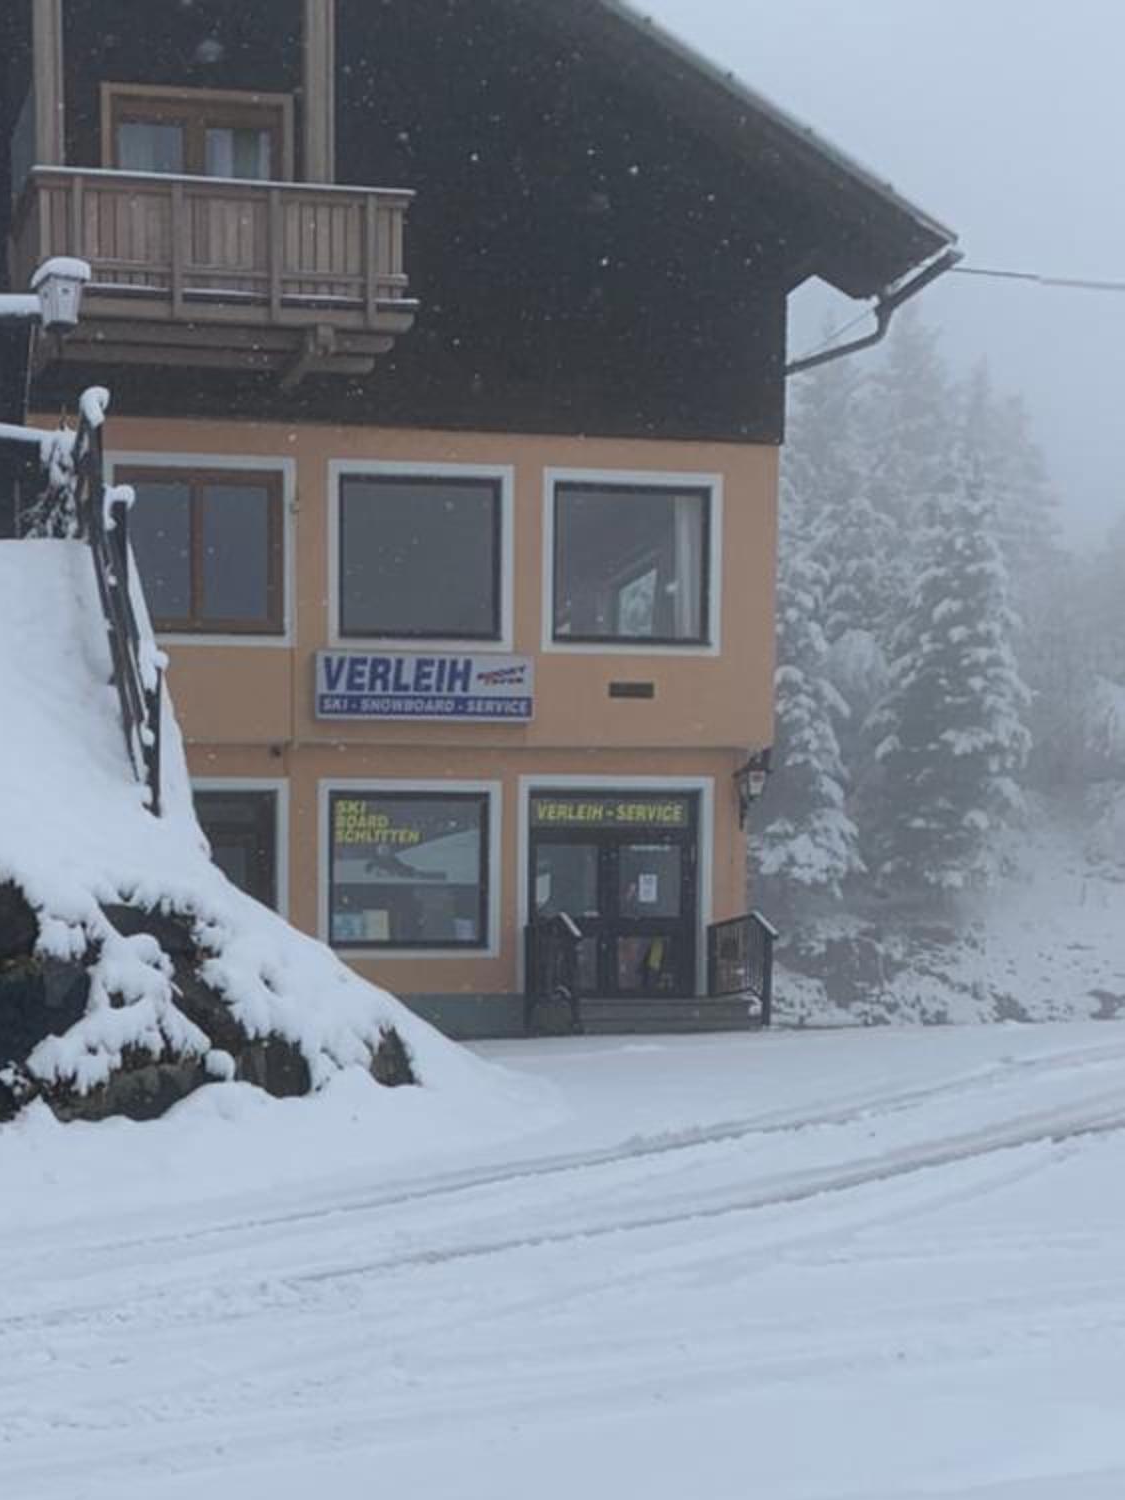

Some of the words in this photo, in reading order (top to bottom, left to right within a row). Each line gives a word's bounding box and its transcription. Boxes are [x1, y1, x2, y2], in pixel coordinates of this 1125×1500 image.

[324, 656, 473, 693] VERLEIH
[324, 699, 349, 711] SKI
[360, 700, 455, 713] SNOWBOARD
[466, 701, 530, 714] SERVICE
[336, 800, 366, 815] SKI
[538, 803, 604, 821] VERLEIH
[616, 804, 684, 822] SERVICE
[336, 815, 390, 829] BOARD
[336, 830, 421, 844] SCHLITTEN
